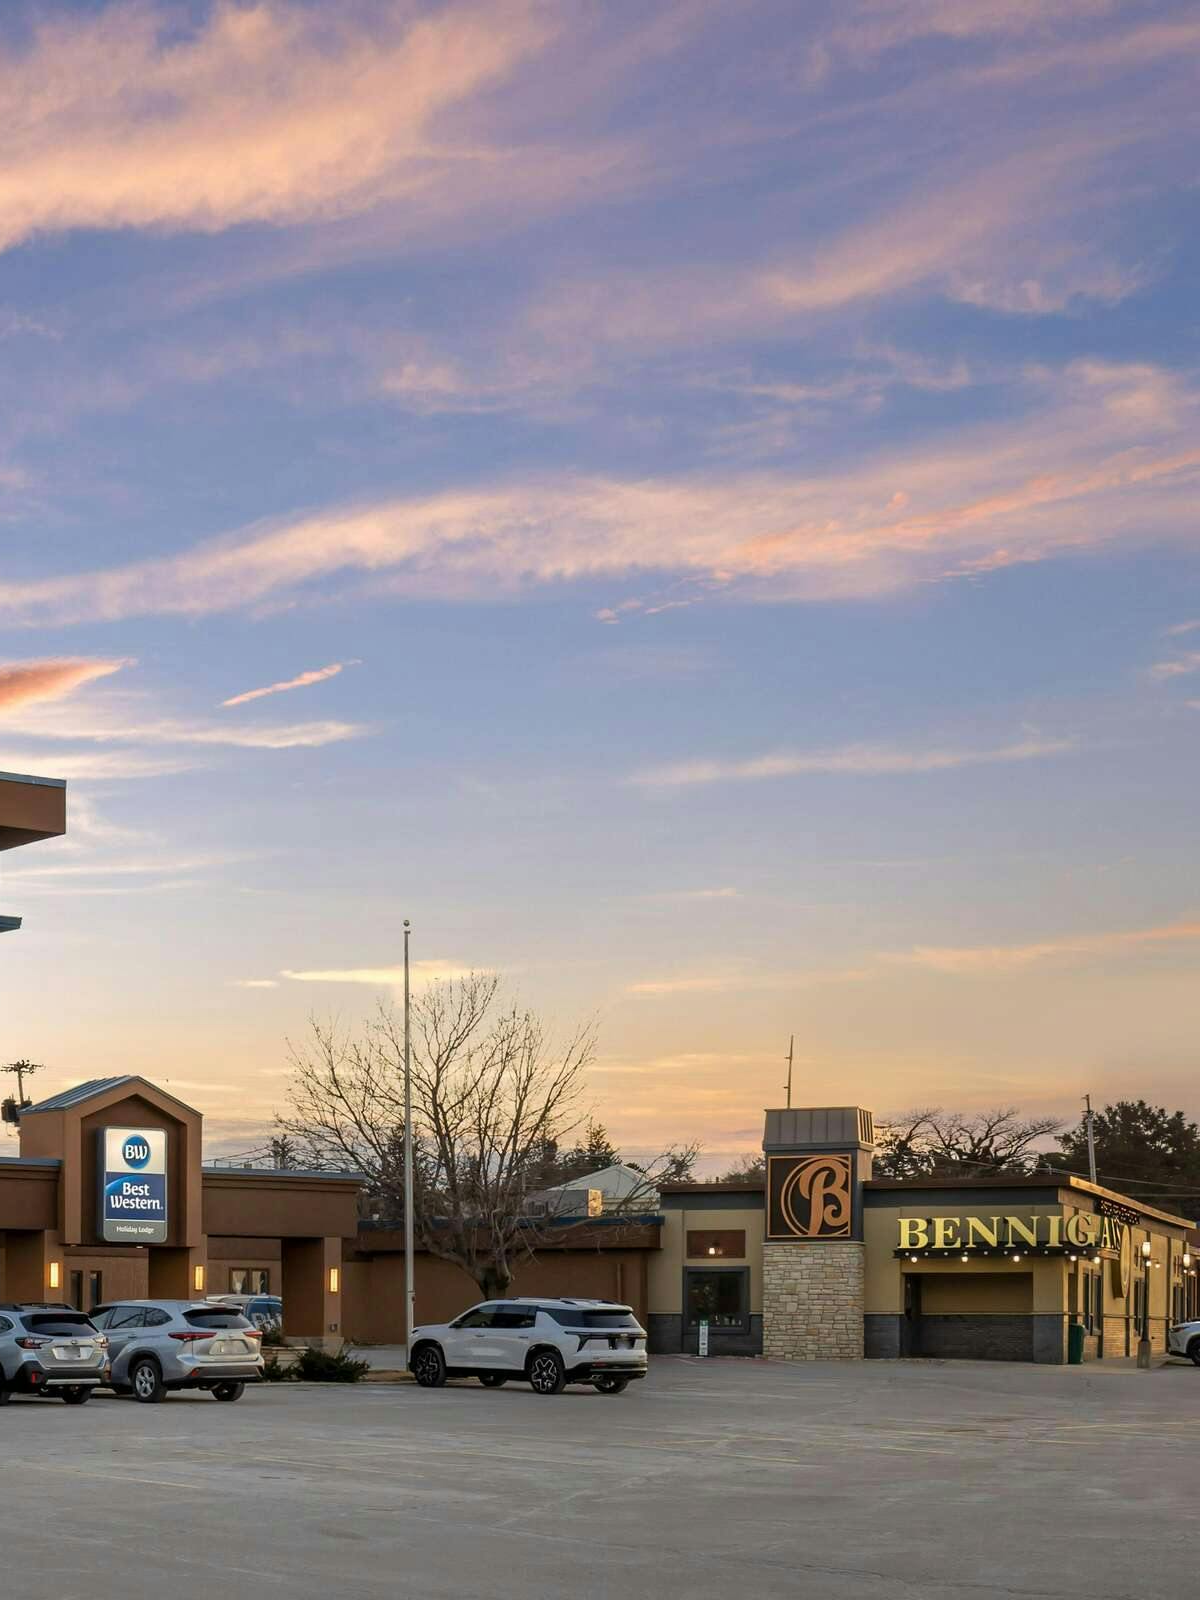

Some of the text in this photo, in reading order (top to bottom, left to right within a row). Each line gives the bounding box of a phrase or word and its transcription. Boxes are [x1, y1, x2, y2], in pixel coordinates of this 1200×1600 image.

[125, 1144, 148, 1160] BW
[122, 1182, 150, 1196] Best
[110, 1195, 160, 1210] Western
